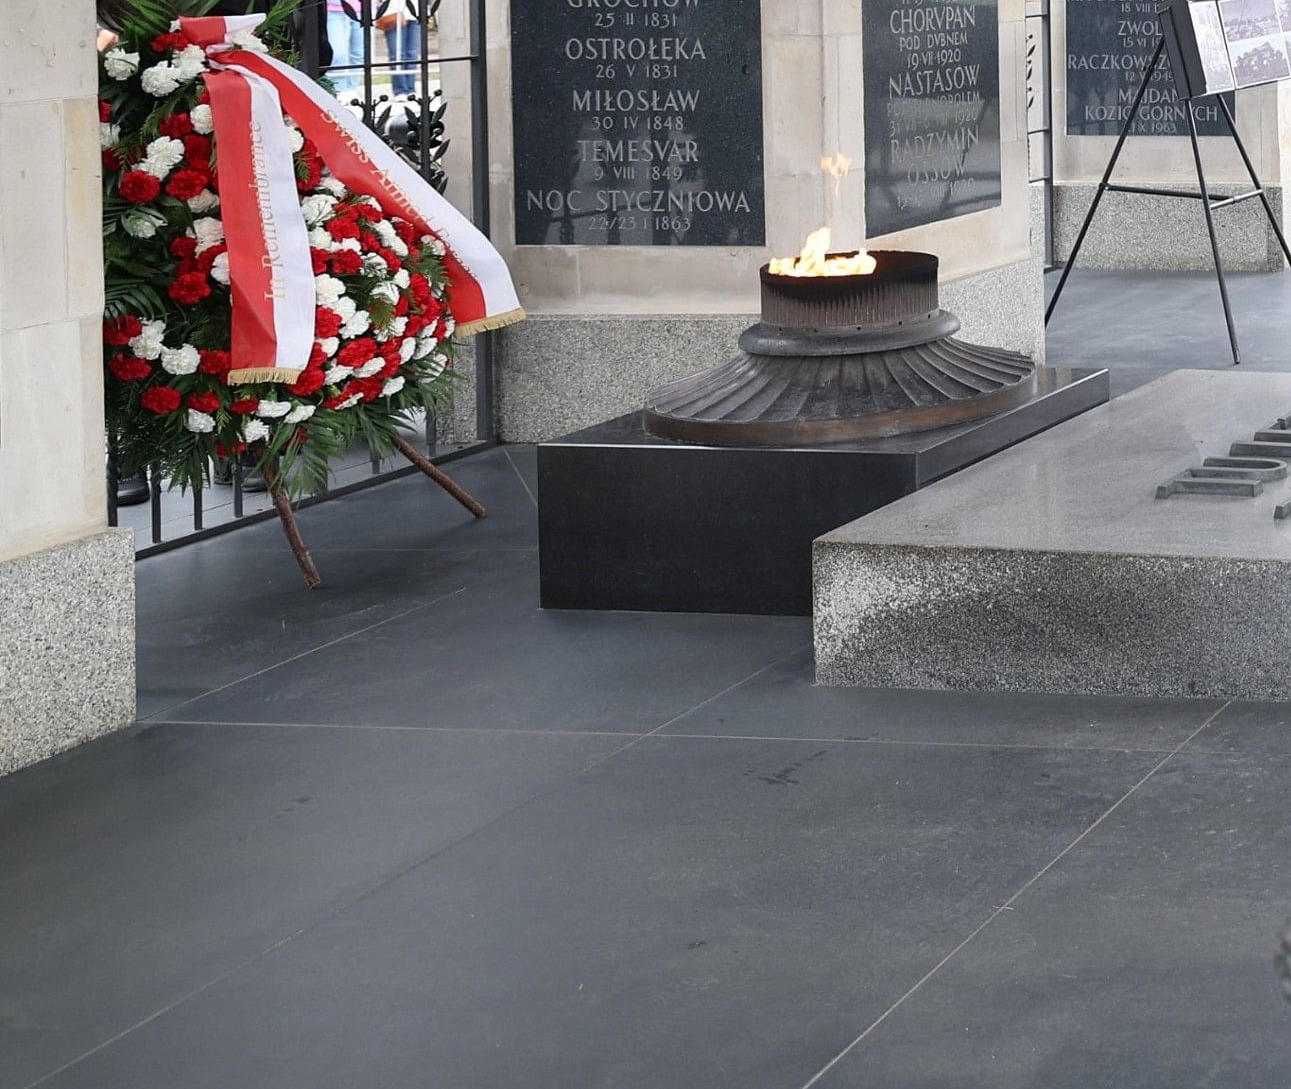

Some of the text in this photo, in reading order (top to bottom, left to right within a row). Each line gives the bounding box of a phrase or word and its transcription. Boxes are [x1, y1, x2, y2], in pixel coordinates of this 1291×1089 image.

[1122, 3, 1150, 12] 18 VIII
[595, 13, 676, 28] 25 II 1831
[900, 36, 920, 51] POD
[1123, 38, 1146, 47] 15 VI
[596, 65, 677, 79] 26 V 1831
[573, 90, 700, 112] MIŁOSŁAW
[591, 116, 684, 130] 30 IV 1848
[320, 110, 369, 164] Swiss
[595, 166, 683, 181] 9 VIII 1849
[248, 121, 284, 269] Remembrance
[527, 190, 751, 212] NOC STYCZNIOWA
[655, 217, 691, 231] 1863
